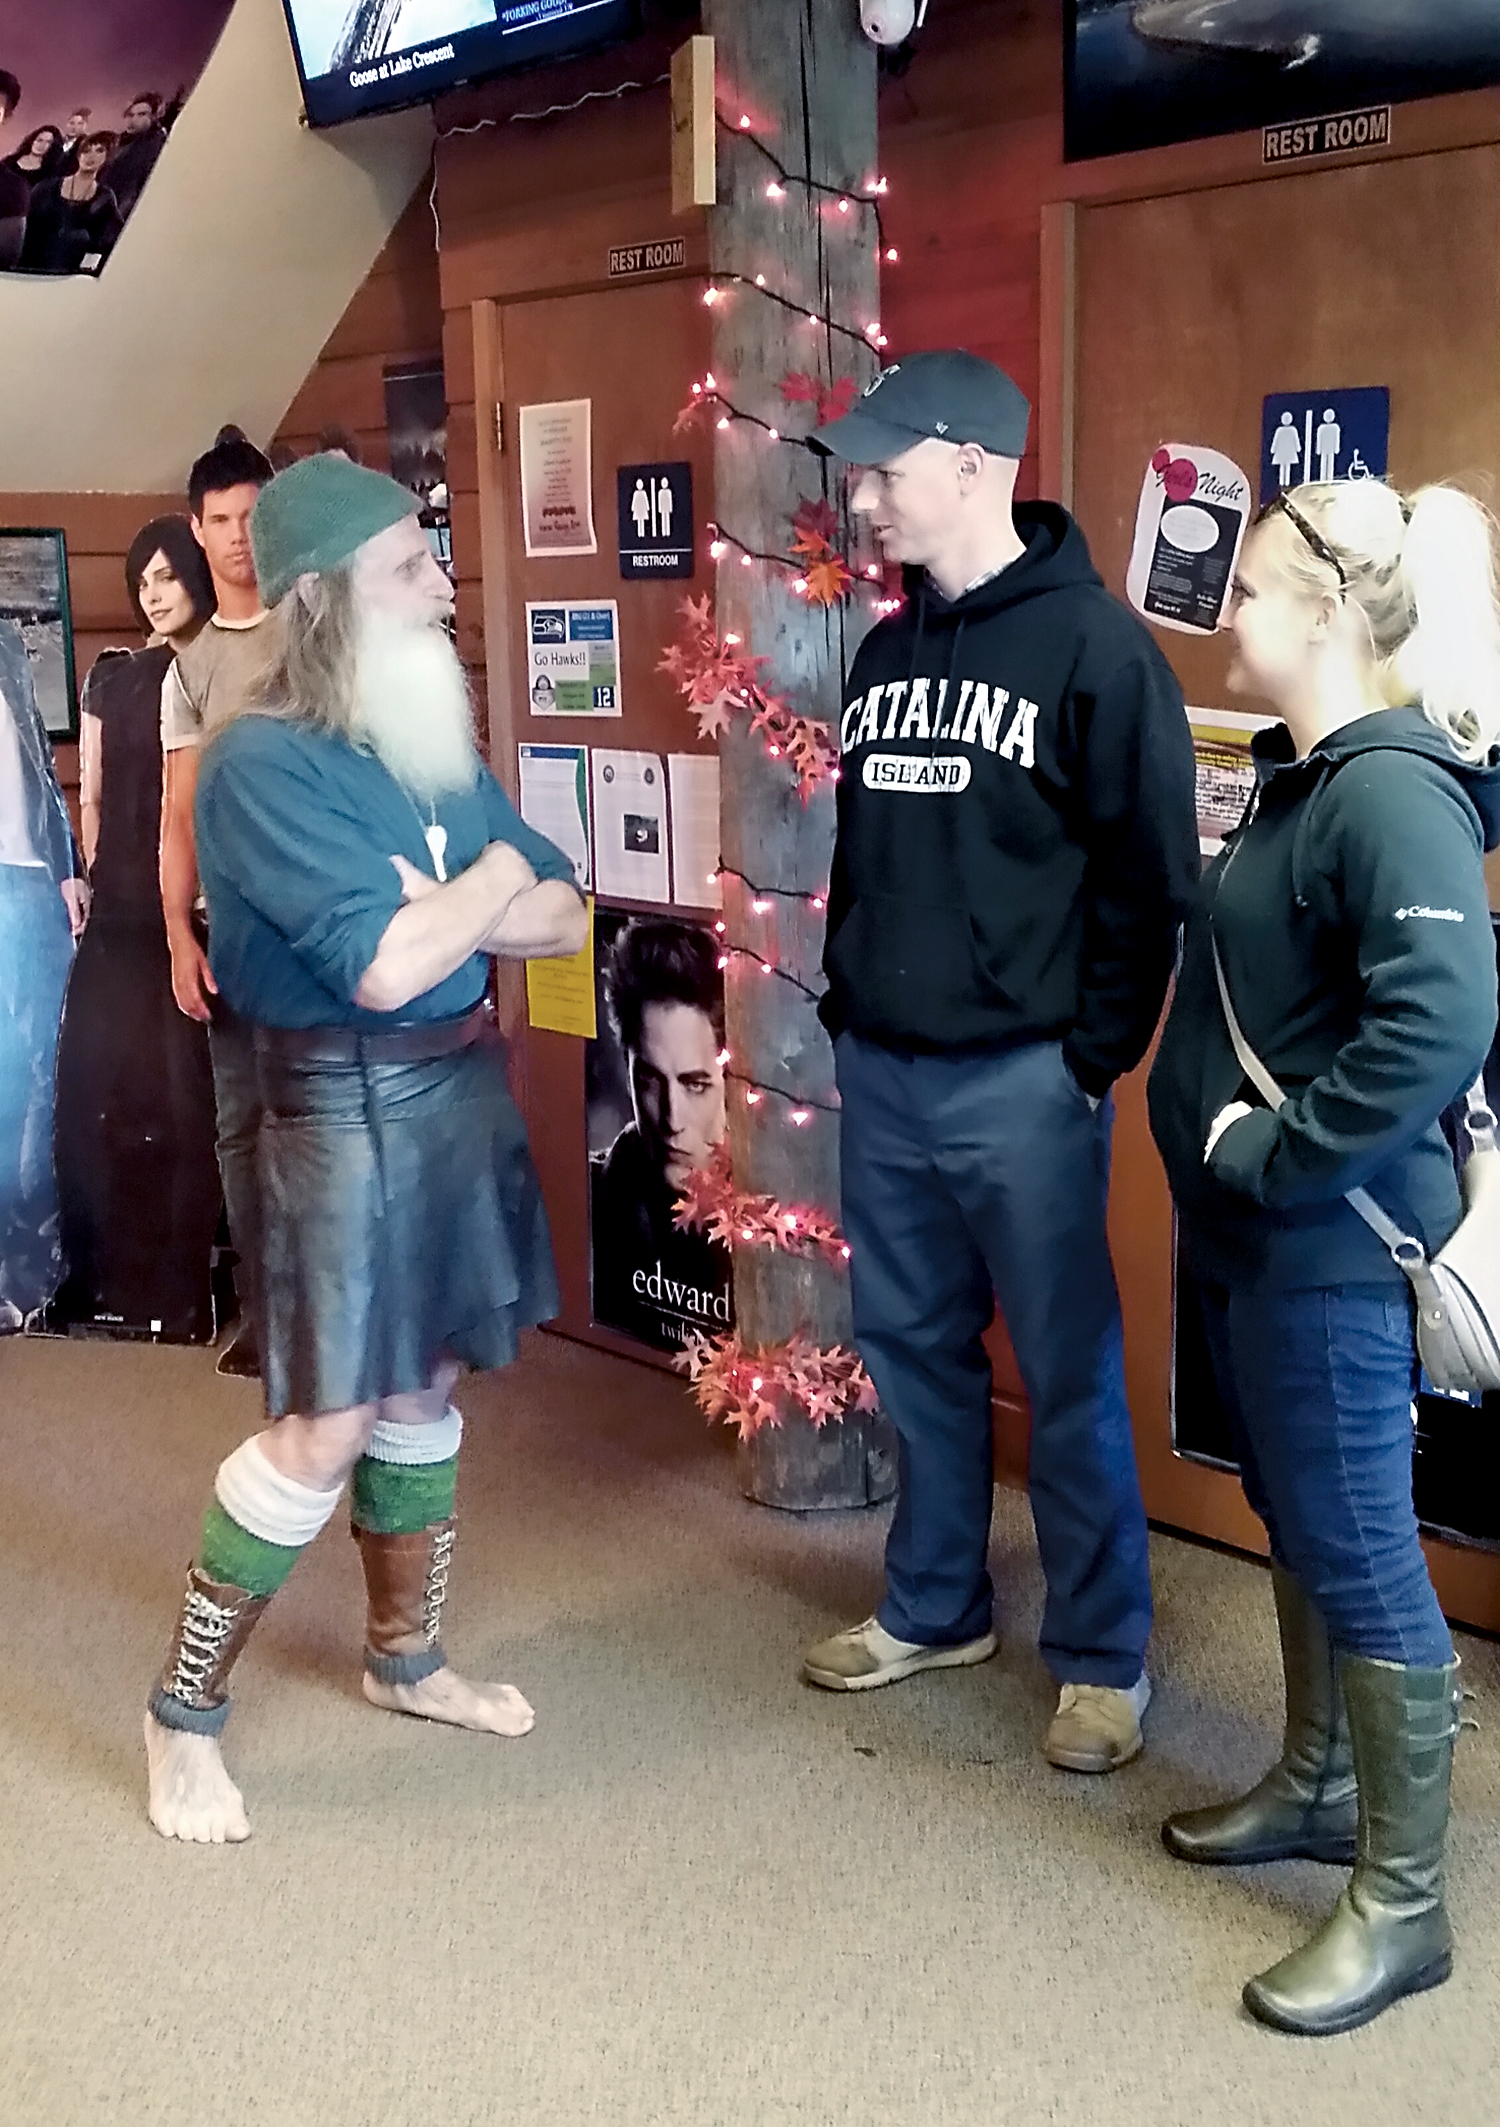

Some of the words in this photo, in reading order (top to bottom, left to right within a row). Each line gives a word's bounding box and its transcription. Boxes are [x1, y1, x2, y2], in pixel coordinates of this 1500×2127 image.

[349, 68, 379, 87] Goose
[379, 63, 390, 79] at
[388, 55, 413, 76] Lake
[412, 42, 455, 69] Crescent
[1266, 124, 1319, 159] REST
[1324, 112, 1387, 149] ROOM
[611, 249, 643, 272] REST
[645, 242, 683, 267] ROOM
[1198, 472, 1244, 502] Night
[632, 554, 679, 567] RESTROOM
[534, 652, 549, 666] Go
[551, 652, 586, 666] Hawks!!
[597, 687, 611, 707] 12
[840, 677, 1040, 769] CATALINA
[871, 762, 961, 785] ISLAND
[632, 1259, 731, 1322] edward
